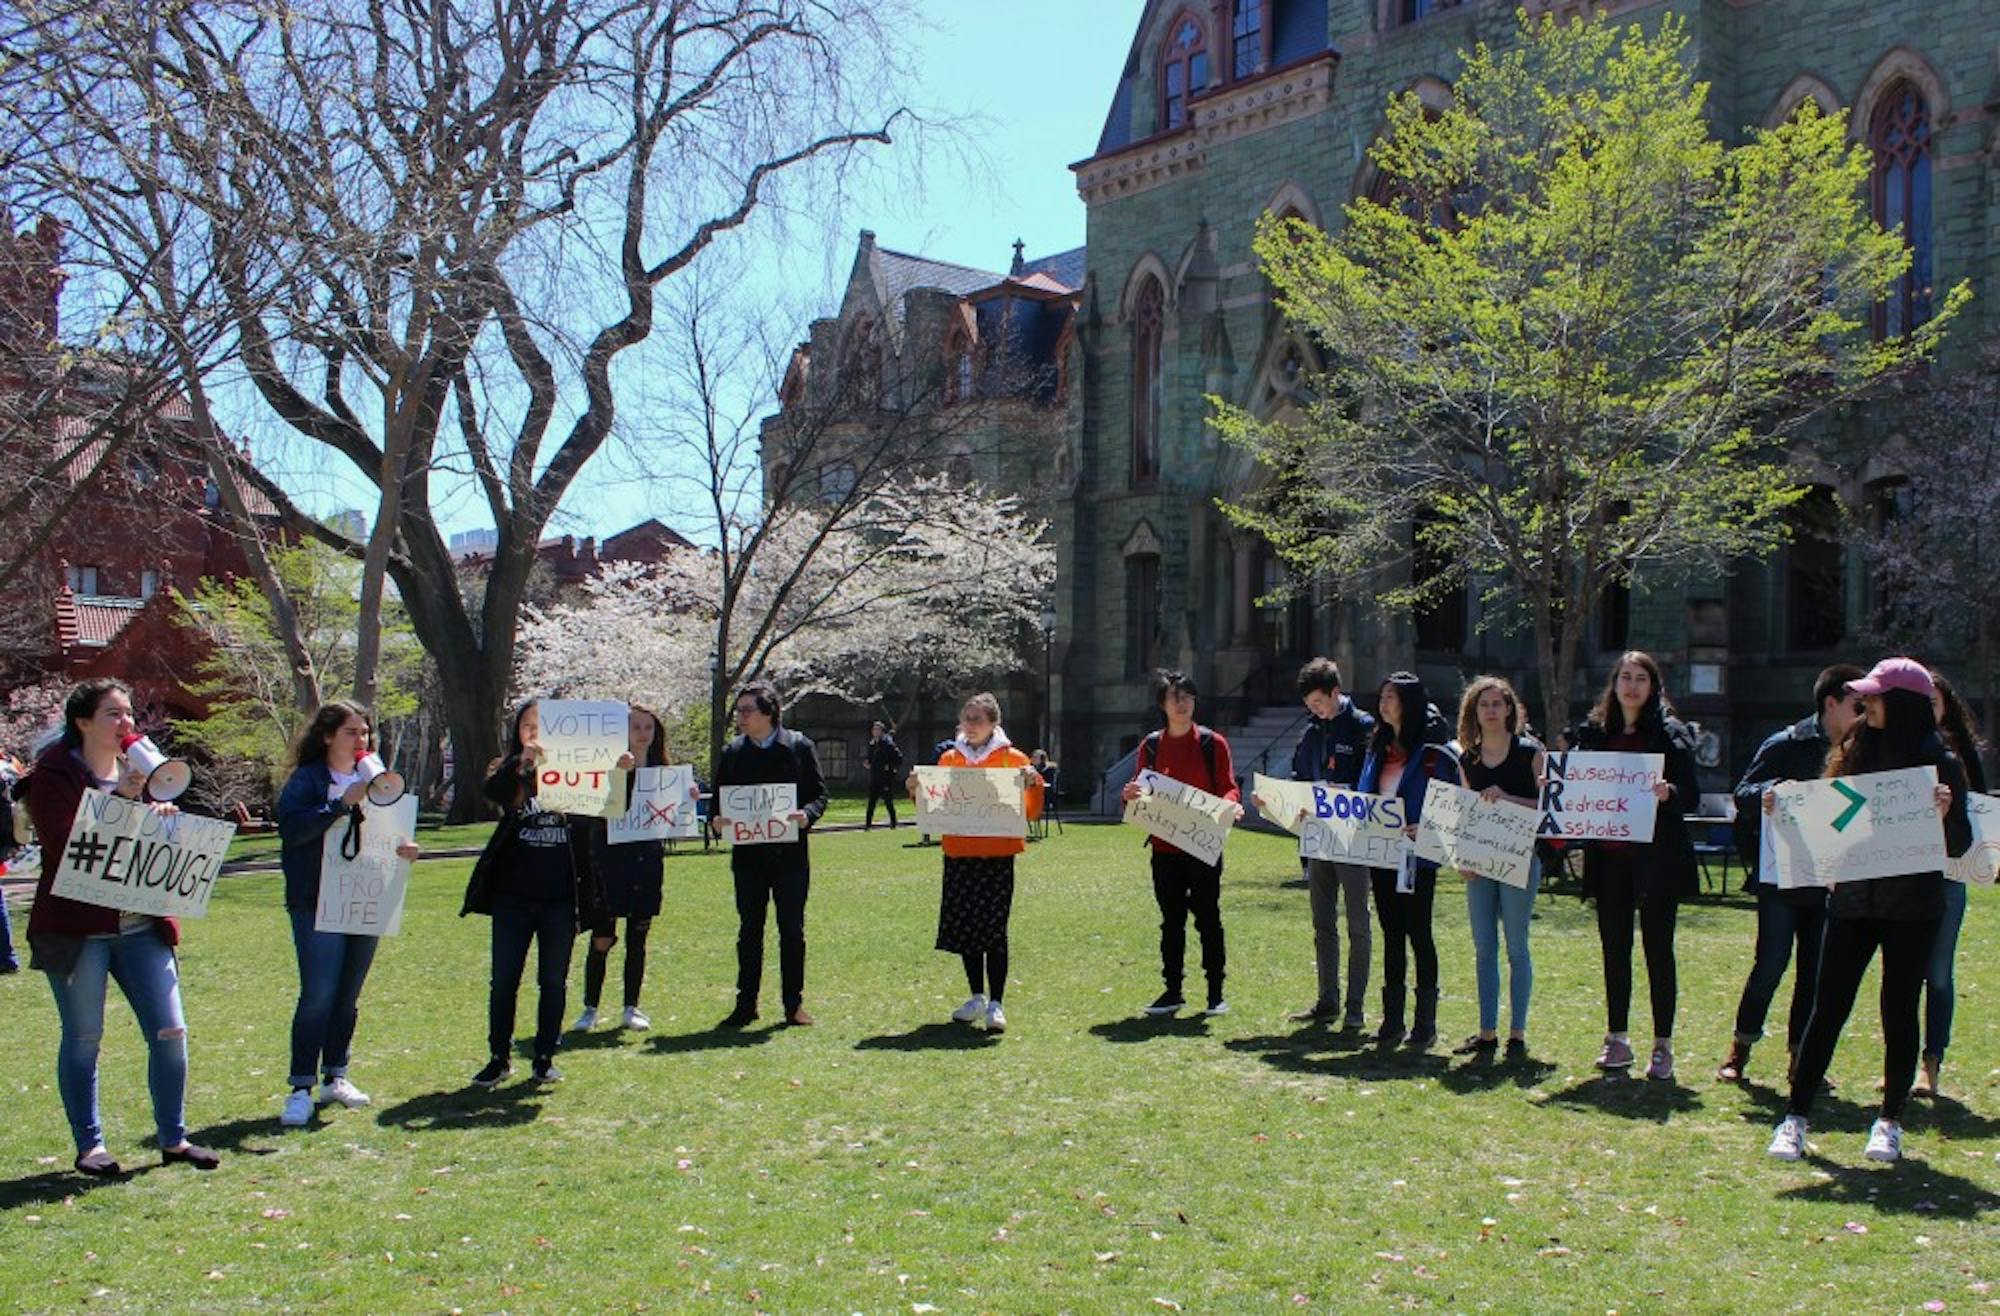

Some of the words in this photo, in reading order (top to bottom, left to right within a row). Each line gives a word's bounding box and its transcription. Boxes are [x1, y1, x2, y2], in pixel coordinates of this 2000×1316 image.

[541, 712, 618, 737] VOTE
[541, 770, 606, 789] OUT
[1546, 754, 1657, 792] Nauseating
[727, 785, 792, 812] GUNS
[1145, 774, 1185, 805] Send
[1542, 780, 1629, 812] Redneck
[82, 793, 139, 829] NOT
[1312, 785, 1402, 828] BOOKS
[735, 819, 787, 841] BAD
[1536, 812, 1631, 837] Assholes
[1304, 821, 1405, 864] BULLETS
[68, 832, 223, 904] #ENOUGH
[339, 874, 385, 899] PRO
[320, 900, 377, 925] LIFE
